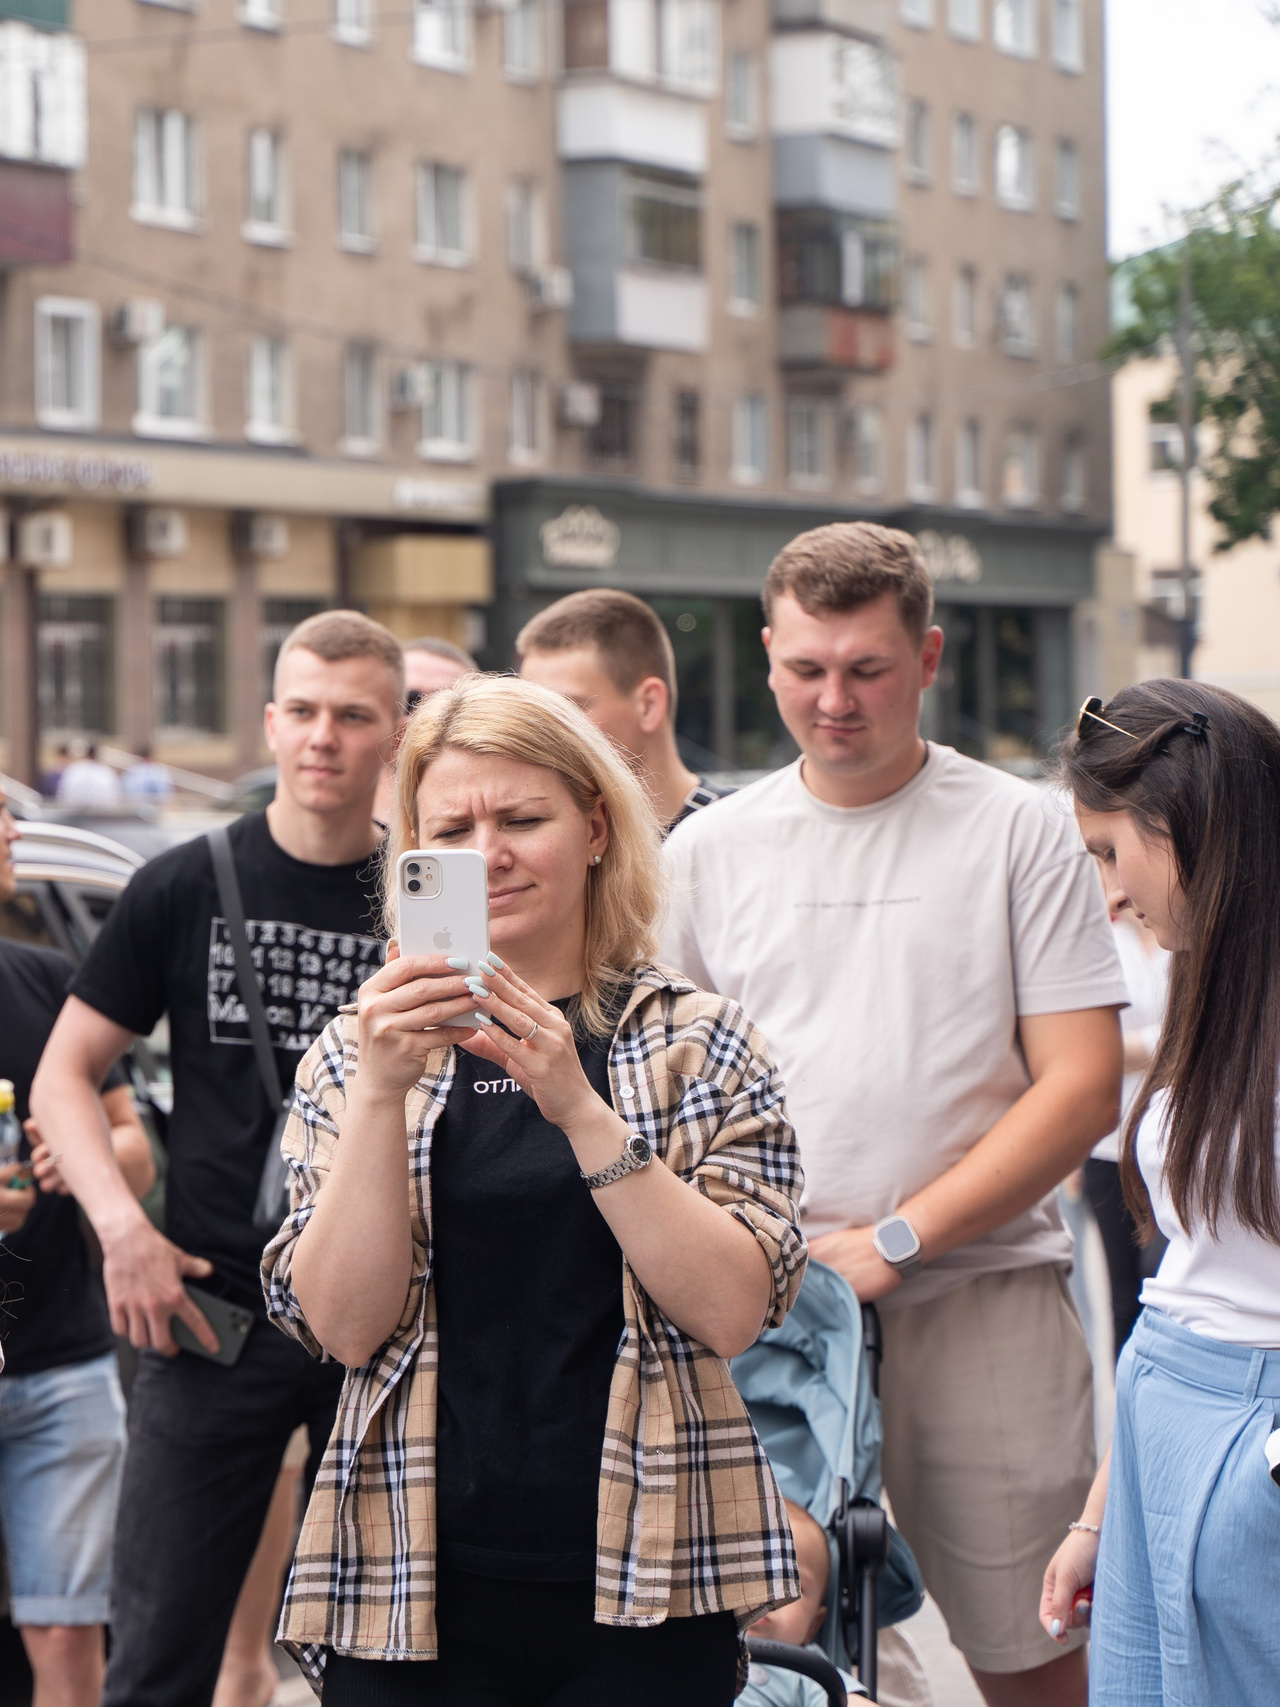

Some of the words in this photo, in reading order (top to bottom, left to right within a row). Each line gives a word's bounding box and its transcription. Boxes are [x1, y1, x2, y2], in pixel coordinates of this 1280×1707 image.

[259, 921, 277, 945] 2
[280, 923, 297, 946] 3
[298, 928, 315, 949] 4
[318, 933, 336, 955] 5
[338, 936, 356, 958] 6
[358, 939, 376, 961] 7
[268, 946, 295, 971] 12
[297, 950, 323, 975] 13
[324, 958, 352, 983] 14
[209, 969, 236, 992] 17
[294, 978, 321, 1003] 20
[319, 982, 348, 1006] 21
[473, 1078, 521, 1094] ОТЛ
